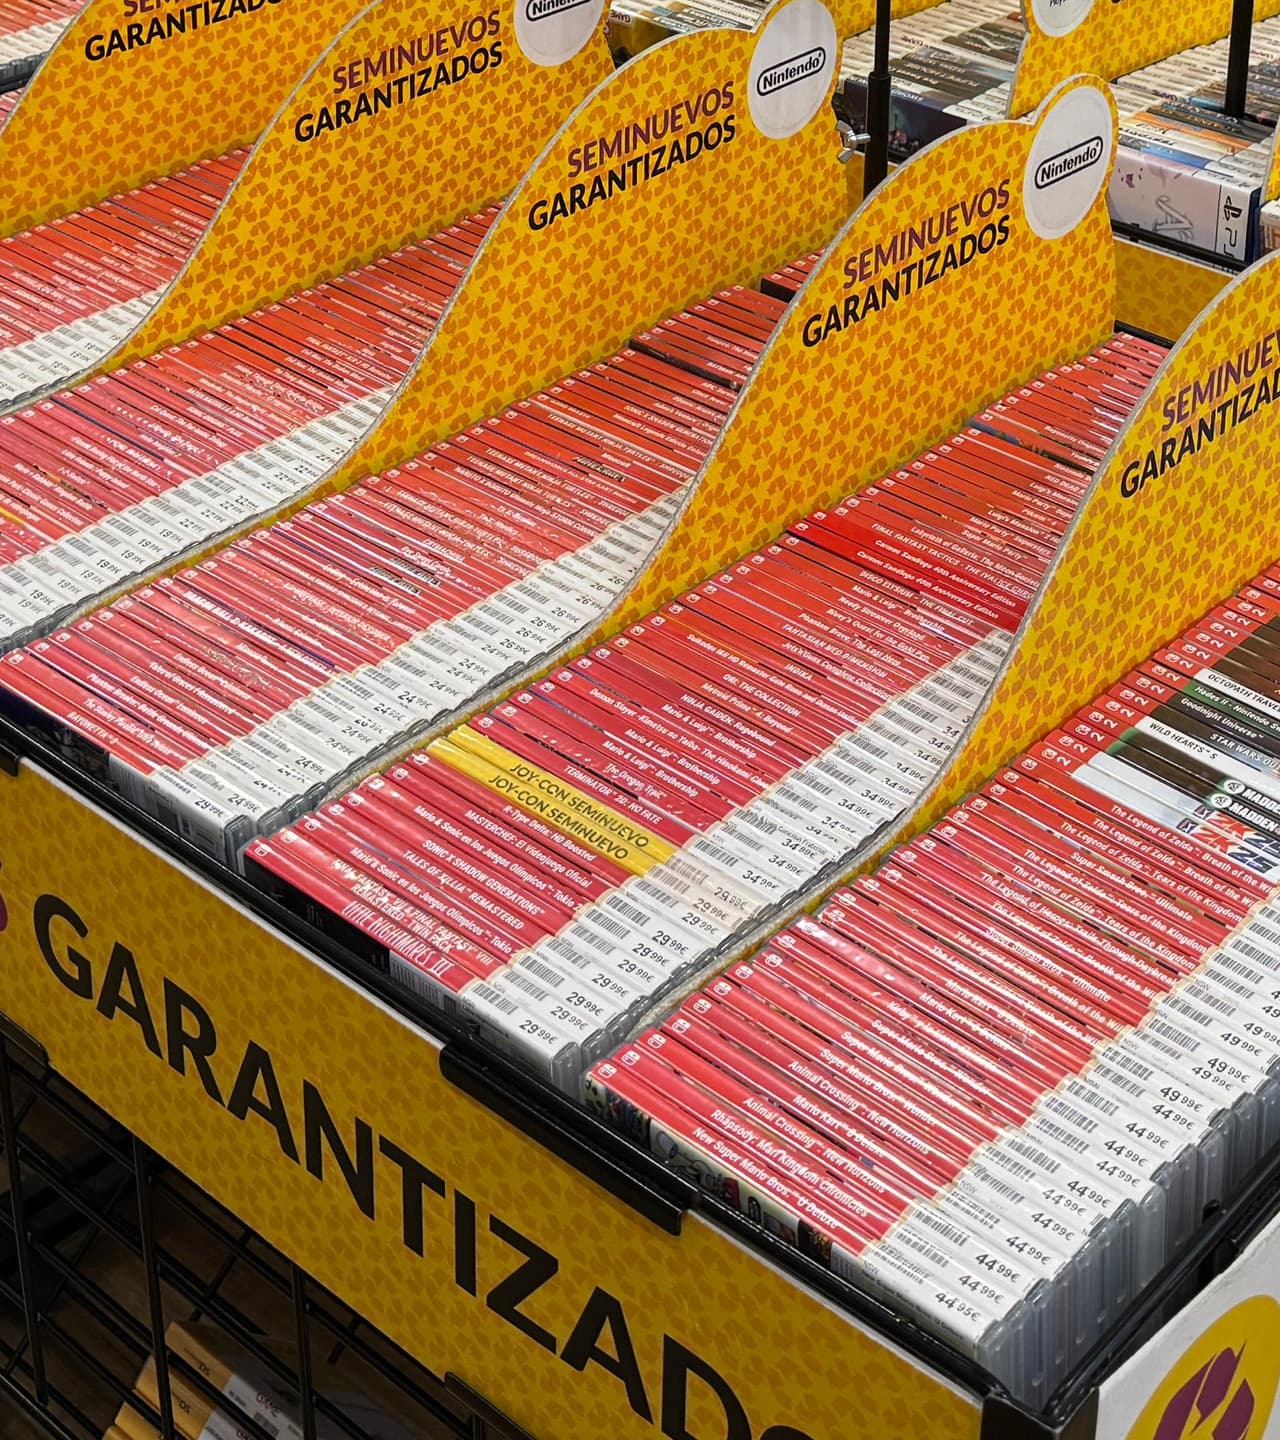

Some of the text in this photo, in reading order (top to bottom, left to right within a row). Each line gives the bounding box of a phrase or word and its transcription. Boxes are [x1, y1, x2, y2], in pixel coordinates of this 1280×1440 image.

[1038, 143, 1101, 184] Nintendo
[844, 179, 1011, 290] SEMINUEVOS
[801, 215, 1010, 348] GARANTIZADOS
[1208, 674, 1250, 698] OCTOPATH
[1149, 722, 1203, 754] WILD HEARTS
[510, 763, 649, 848] JOY-CON SEMINUEVO
[32, 893, 814, 1440] GARANTIZAD
